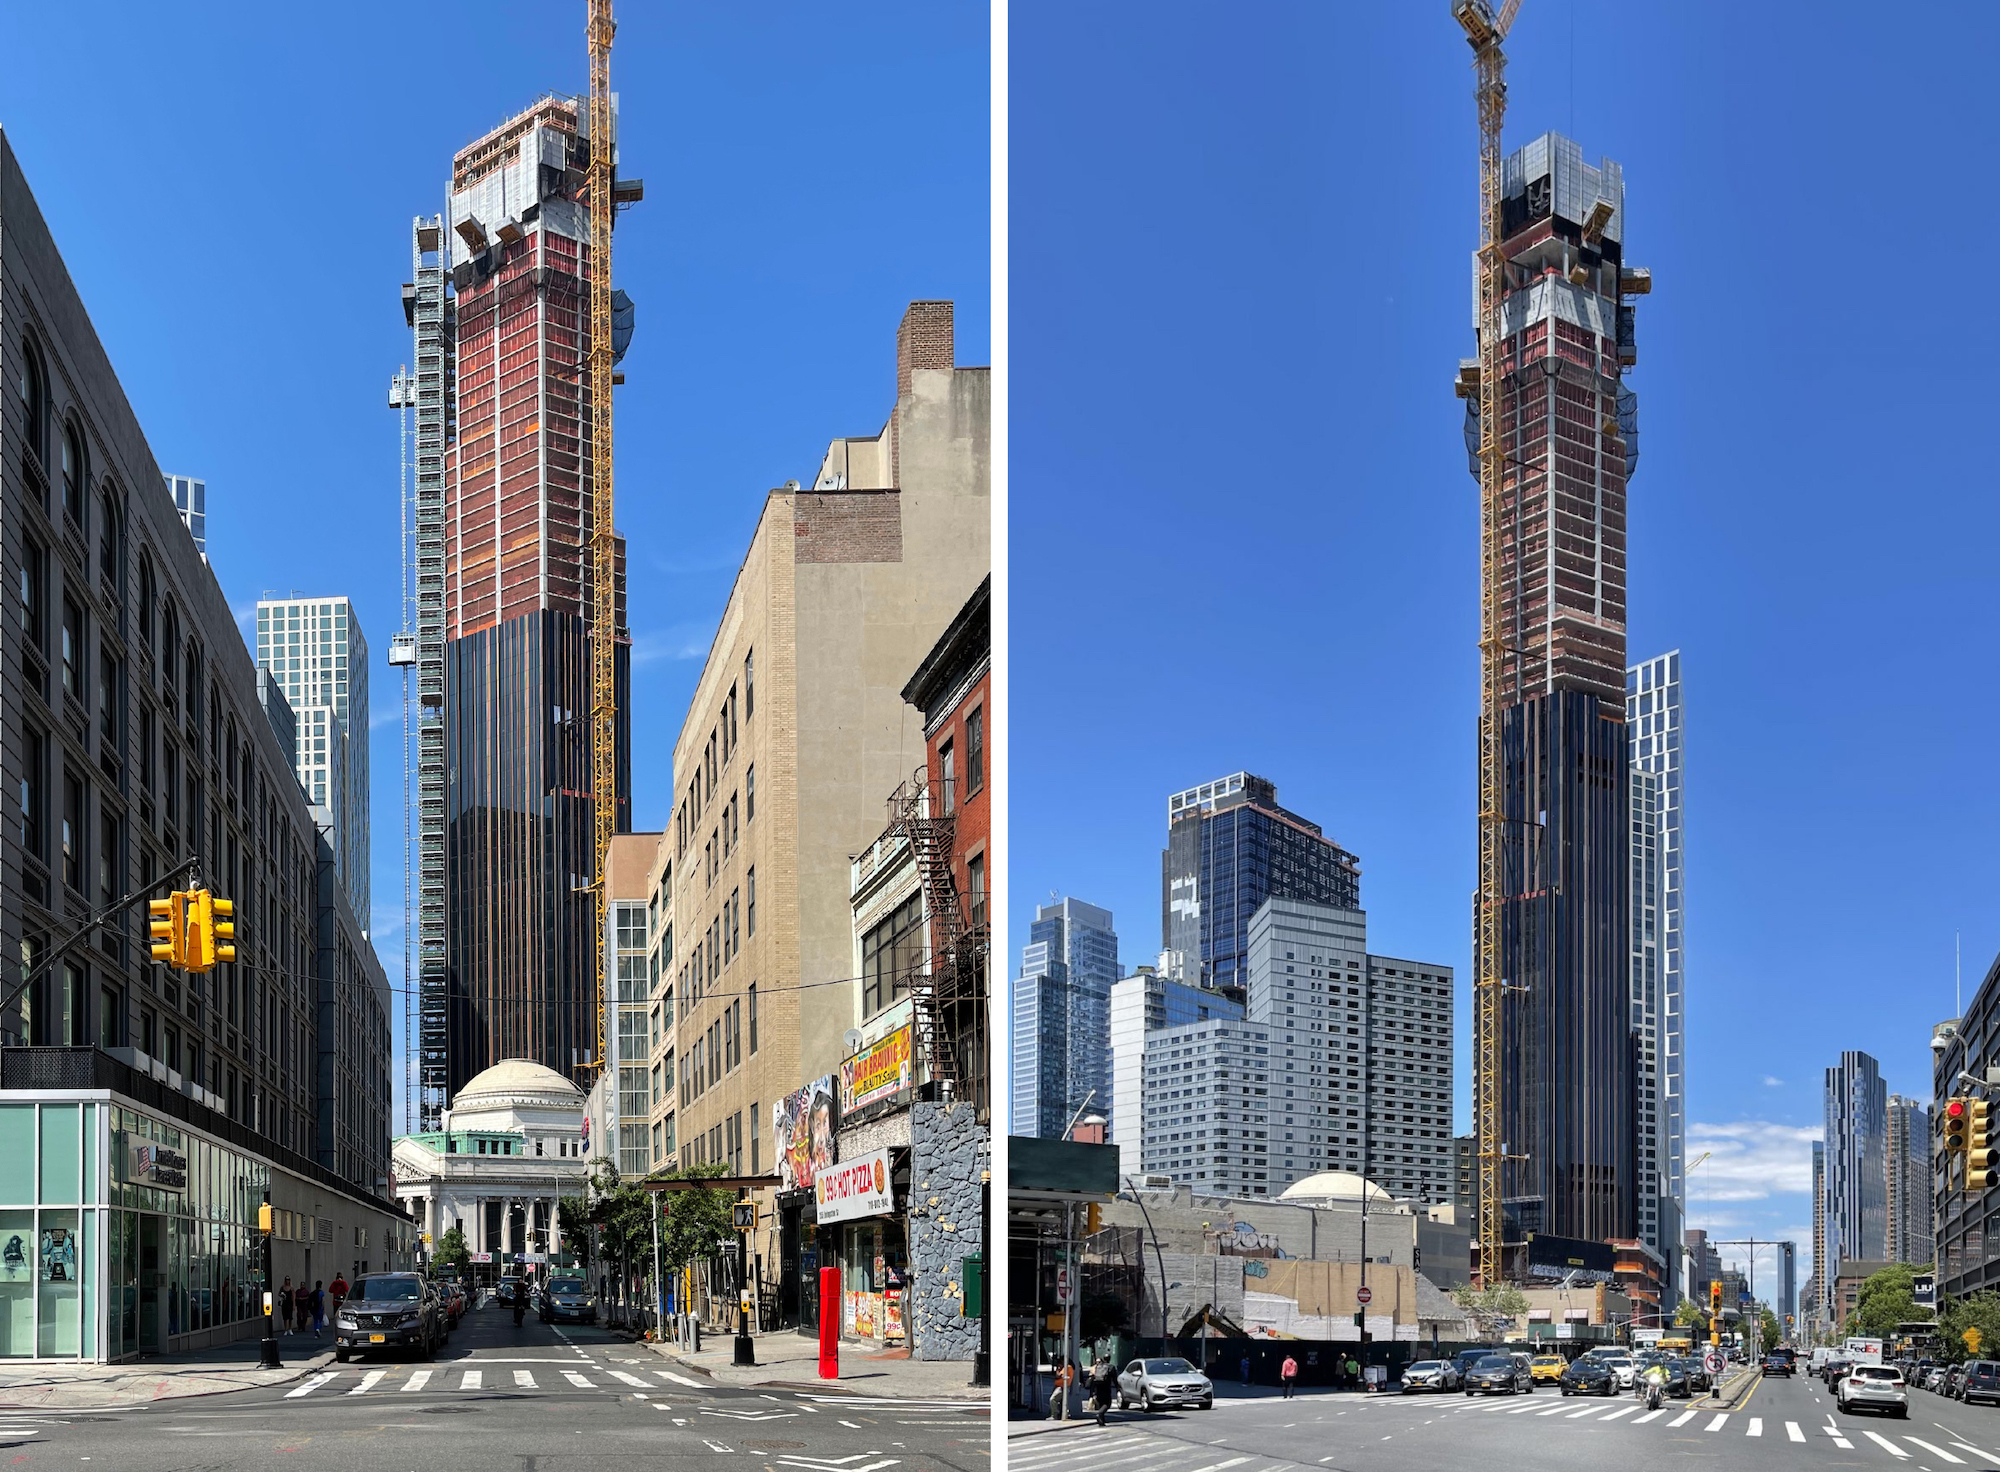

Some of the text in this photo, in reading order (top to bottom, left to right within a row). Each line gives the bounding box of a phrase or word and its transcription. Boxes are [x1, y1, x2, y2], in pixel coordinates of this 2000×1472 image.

[854, 1059, 868, 1084] HAIR
[869, 1042, 897, 1076] BRAIDING
[863, 1073, 883, 1091] BEAUTY
[838, 1169, 851, 1199] HOT
[852, 1163, 874, 1196] PIZZA
[1915, 1284, 1933, 1292] LIU
[886, 1322, 901, 1330] 99¢
[1850, 1343, 1879, 1353] FedEx
